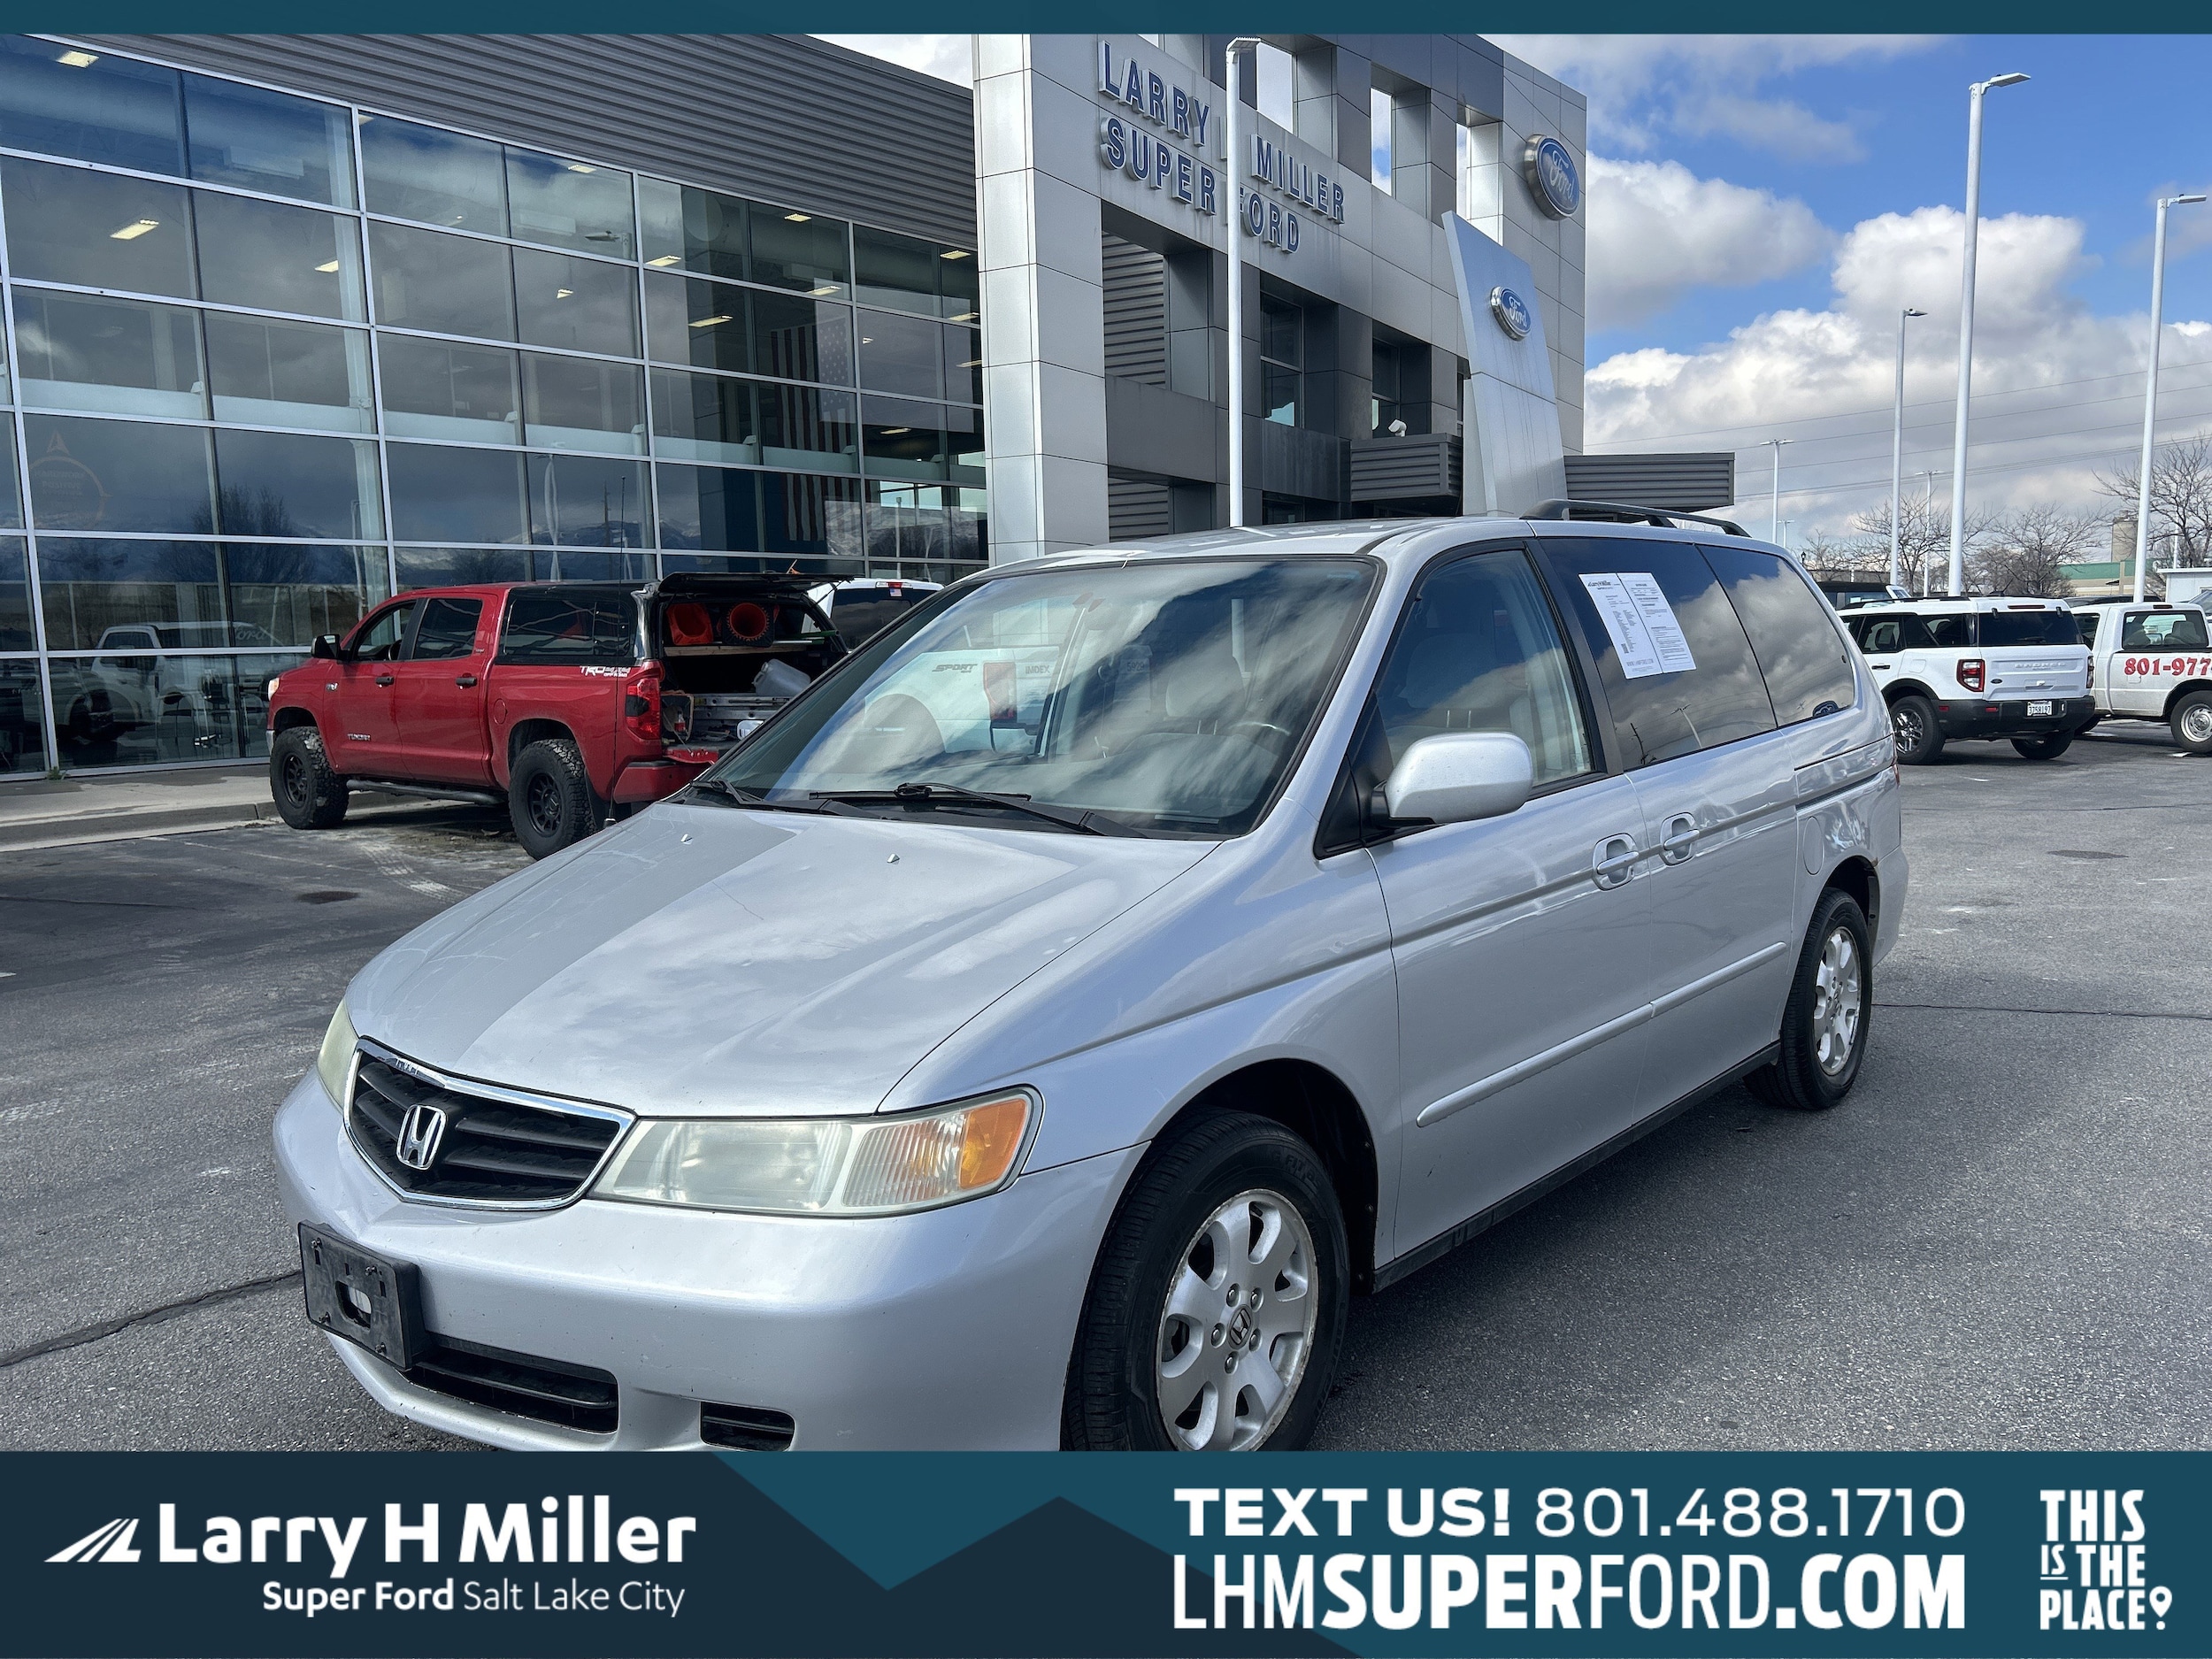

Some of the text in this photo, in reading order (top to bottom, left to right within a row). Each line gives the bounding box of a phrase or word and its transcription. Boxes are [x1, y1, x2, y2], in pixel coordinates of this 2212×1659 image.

[1099, 40, 1210, 147] LARRY
[1251, 134, 1345, 224] MILLER
[1100, 116, 1216, 215] SUPER
[932, 663, 979, 672] SPORT
[2124, 657, 2212, 676] 801-977
